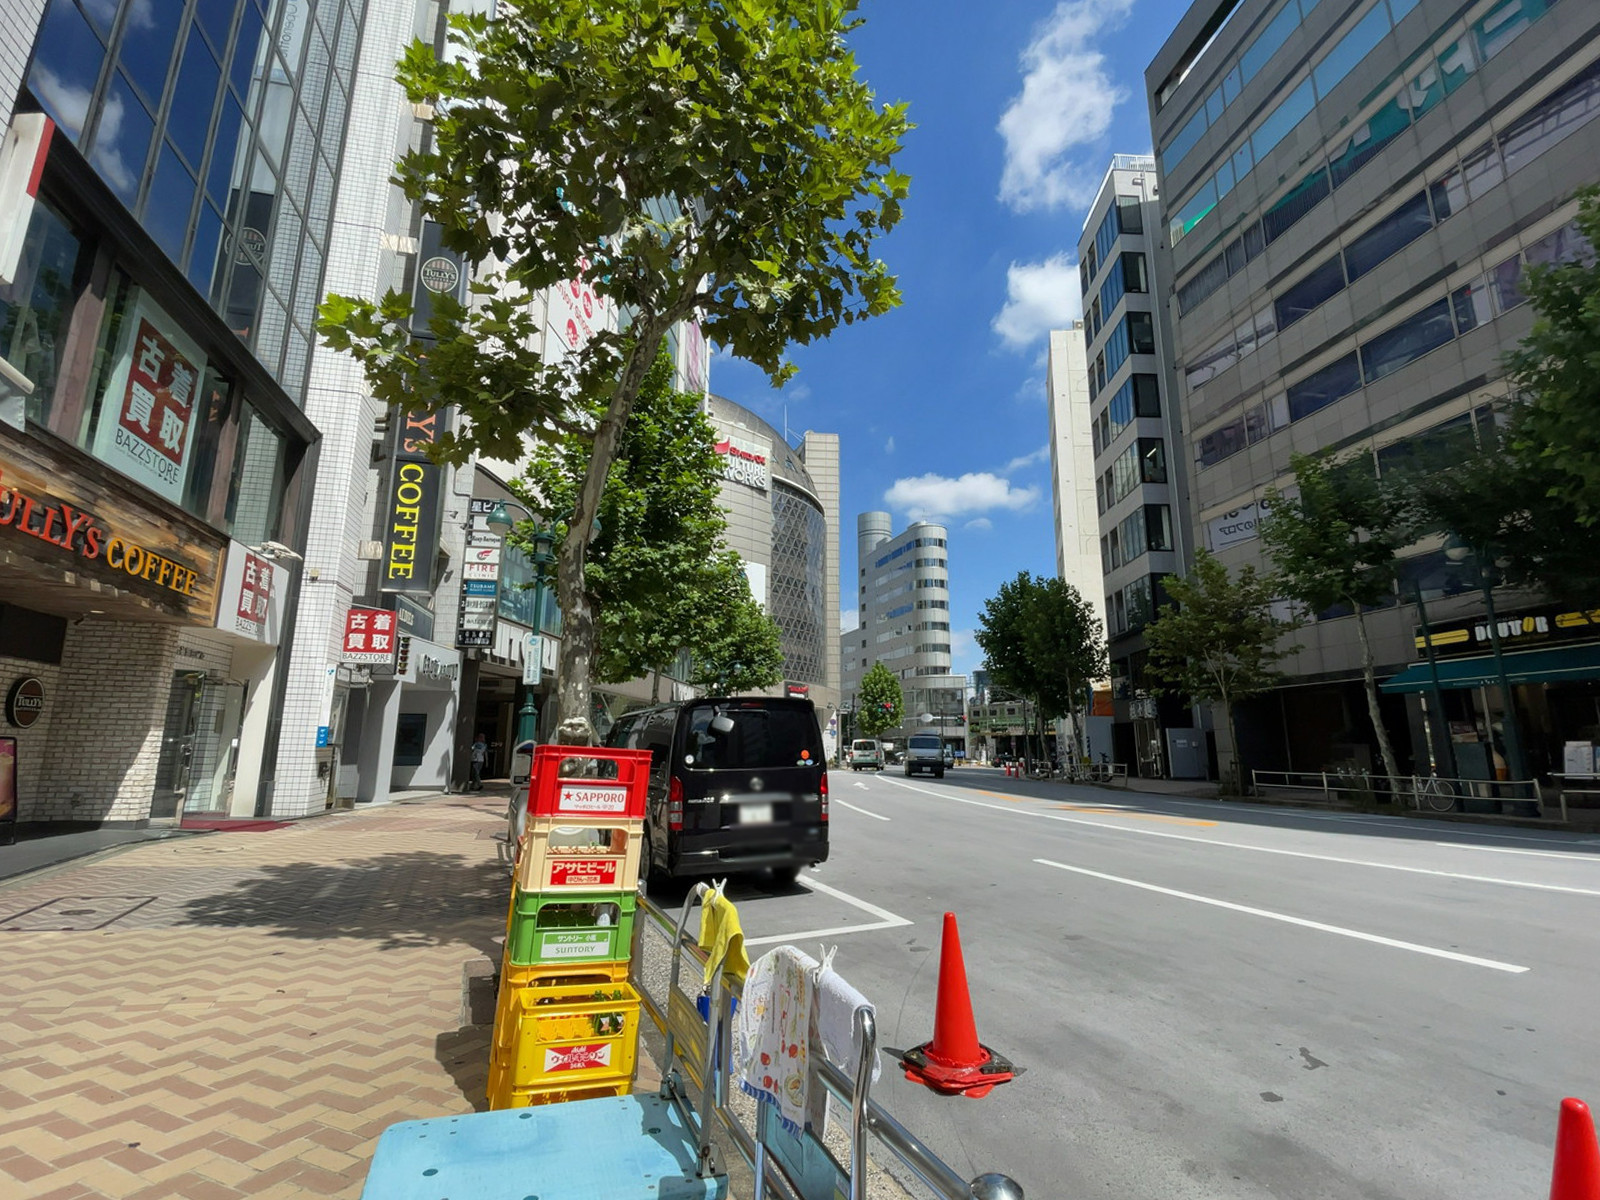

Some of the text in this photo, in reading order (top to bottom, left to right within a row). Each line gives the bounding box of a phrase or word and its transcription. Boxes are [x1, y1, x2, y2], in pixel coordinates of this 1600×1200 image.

[138, 335, 195, 408] 古着
[126, 381, 184, 454] 買取
[115, 428, 180, 483] BAZZSTORE
[728, 456, 766, 477] ULTURE
[388, 463, 424, 579] COFFEE
[0, 469, 198, 597] ULLY'S COFFEE
[246, 561, 271, 592] 古着
[469, 564, 496, 572] FIRE
[350, 613, 392, 630] 古着
[347, 633, 390, 650] 買取
[342, 653, 390, 661] BAZZSTORE
[575, 792, 625, 803] SAPPORO
[552, 862, 615, 874] アサヒビール
[555, 945, 596, 954] SUNTORY
